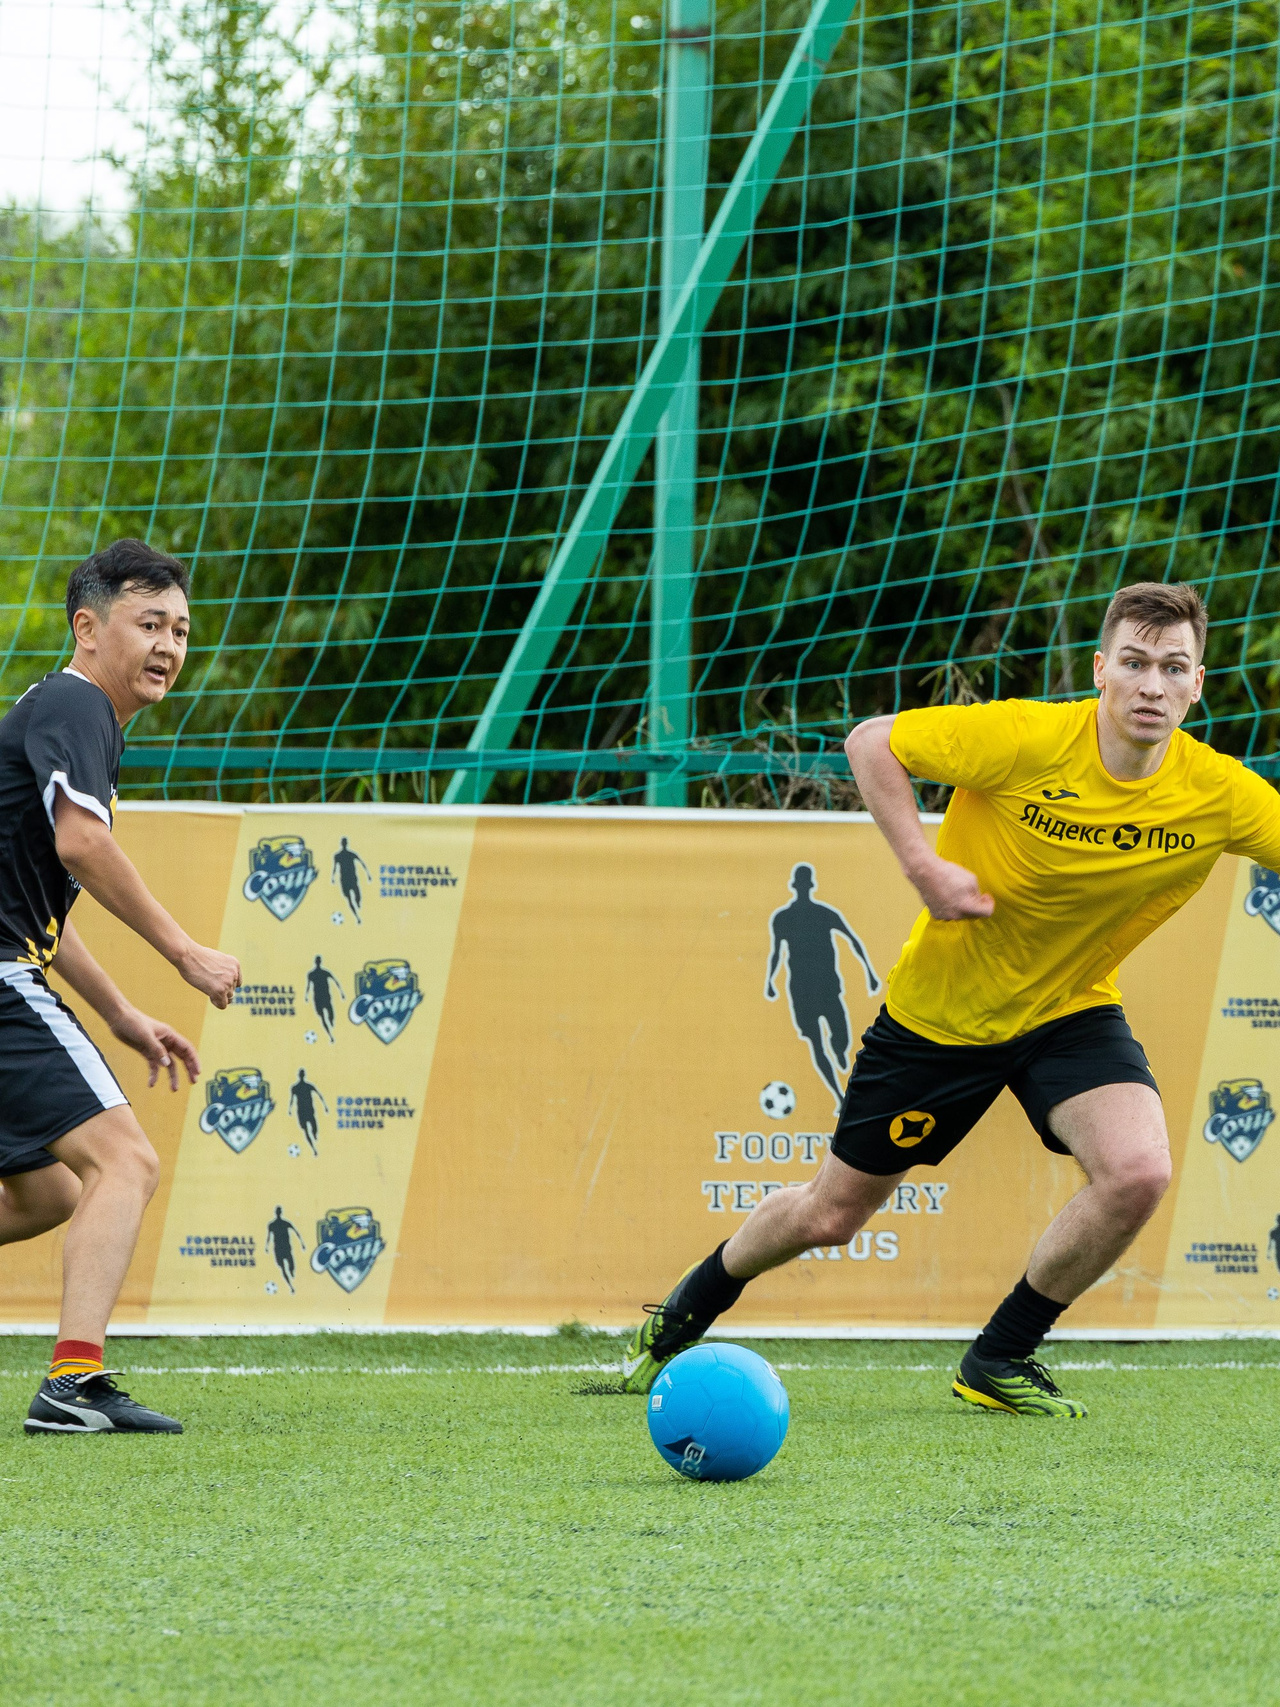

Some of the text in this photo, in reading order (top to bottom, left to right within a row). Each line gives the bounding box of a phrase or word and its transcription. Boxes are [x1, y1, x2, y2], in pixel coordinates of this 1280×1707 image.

[1019, 803, 1196, 853] Яндекс Про
[379, 865, 451, 875] FOOTBALL
[379, 877, 458, 887] TERRITORY
[379, 888, 428, 898] SIRIUS
[234, 985, 295, 994] OOTBALL
[234, 996, 295, 1005] RRITORY
[250, 1007, 296, 1016] SIRIUS
[336, 1097, 408, 1107] FOOTBALL
[336, 1108, 415, 1118] TERRITORY
[337, 1119, 385, 1129] SIRIUS
[186, 1236, 255, 1245] FOOTBALL
[179, 1246, 256, 1256] TERRITORY
[1191, 1243, 1258, 1252] FOOTBALL
[210, 1258, 256, 1267] SIRIUS
[1185, 1253, 1258, 1263] TERRITORY
[1214, 1264, 1259, 1273] SIRIUS
